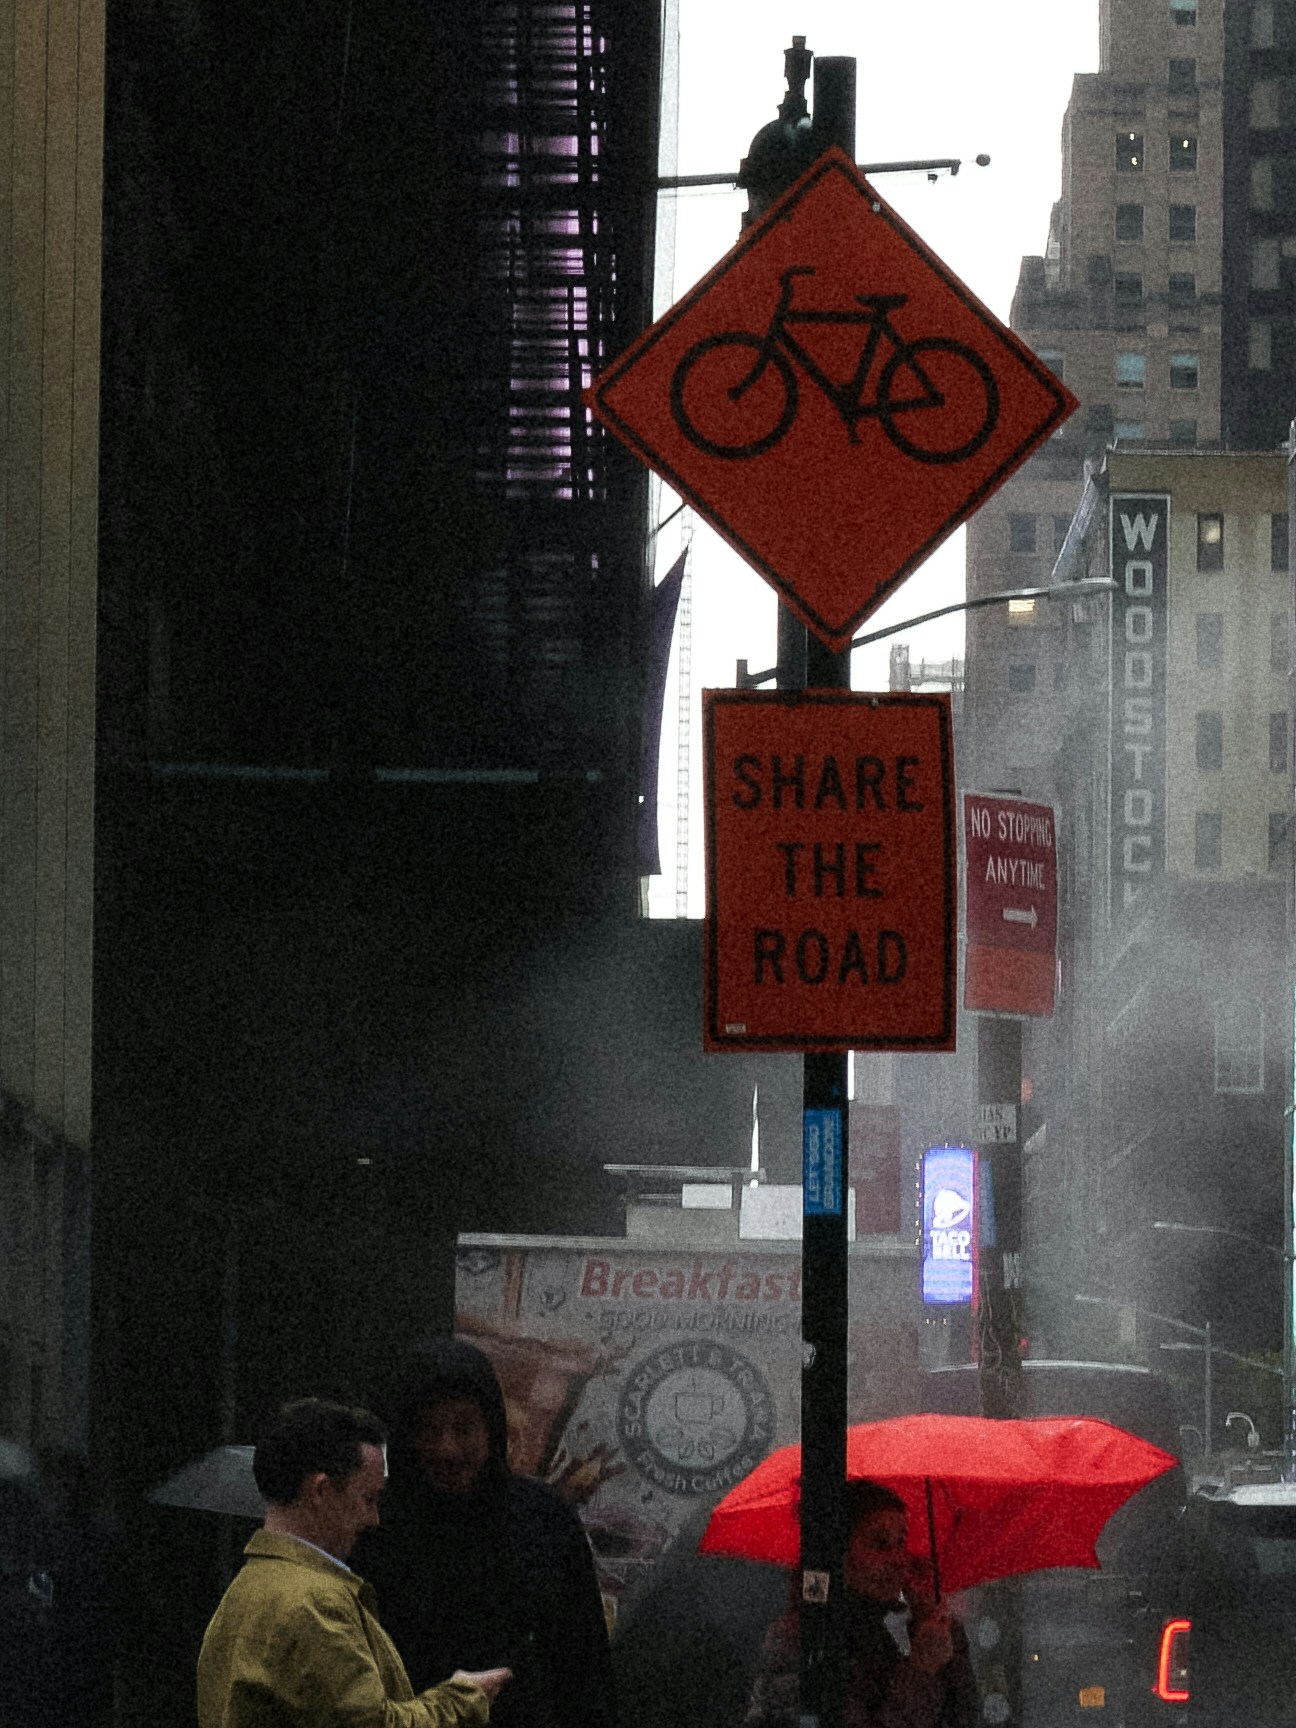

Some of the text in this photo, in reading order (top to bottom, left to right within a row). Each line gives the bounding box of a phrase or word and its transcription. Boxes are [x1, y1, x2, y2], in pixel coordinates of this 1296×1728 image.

[731, 755, 924, 813] SHARE
[971, 807, 1053, 848] NO STOPPING
[776, 843, 883, 898] THE
[985, 855, 1046, 891] ANYTIME
[754, 928, 908, 985] ROAD
[930, 1230, 971, 1245] TACO
[581, 1258, 803, 1302] Breakfast
